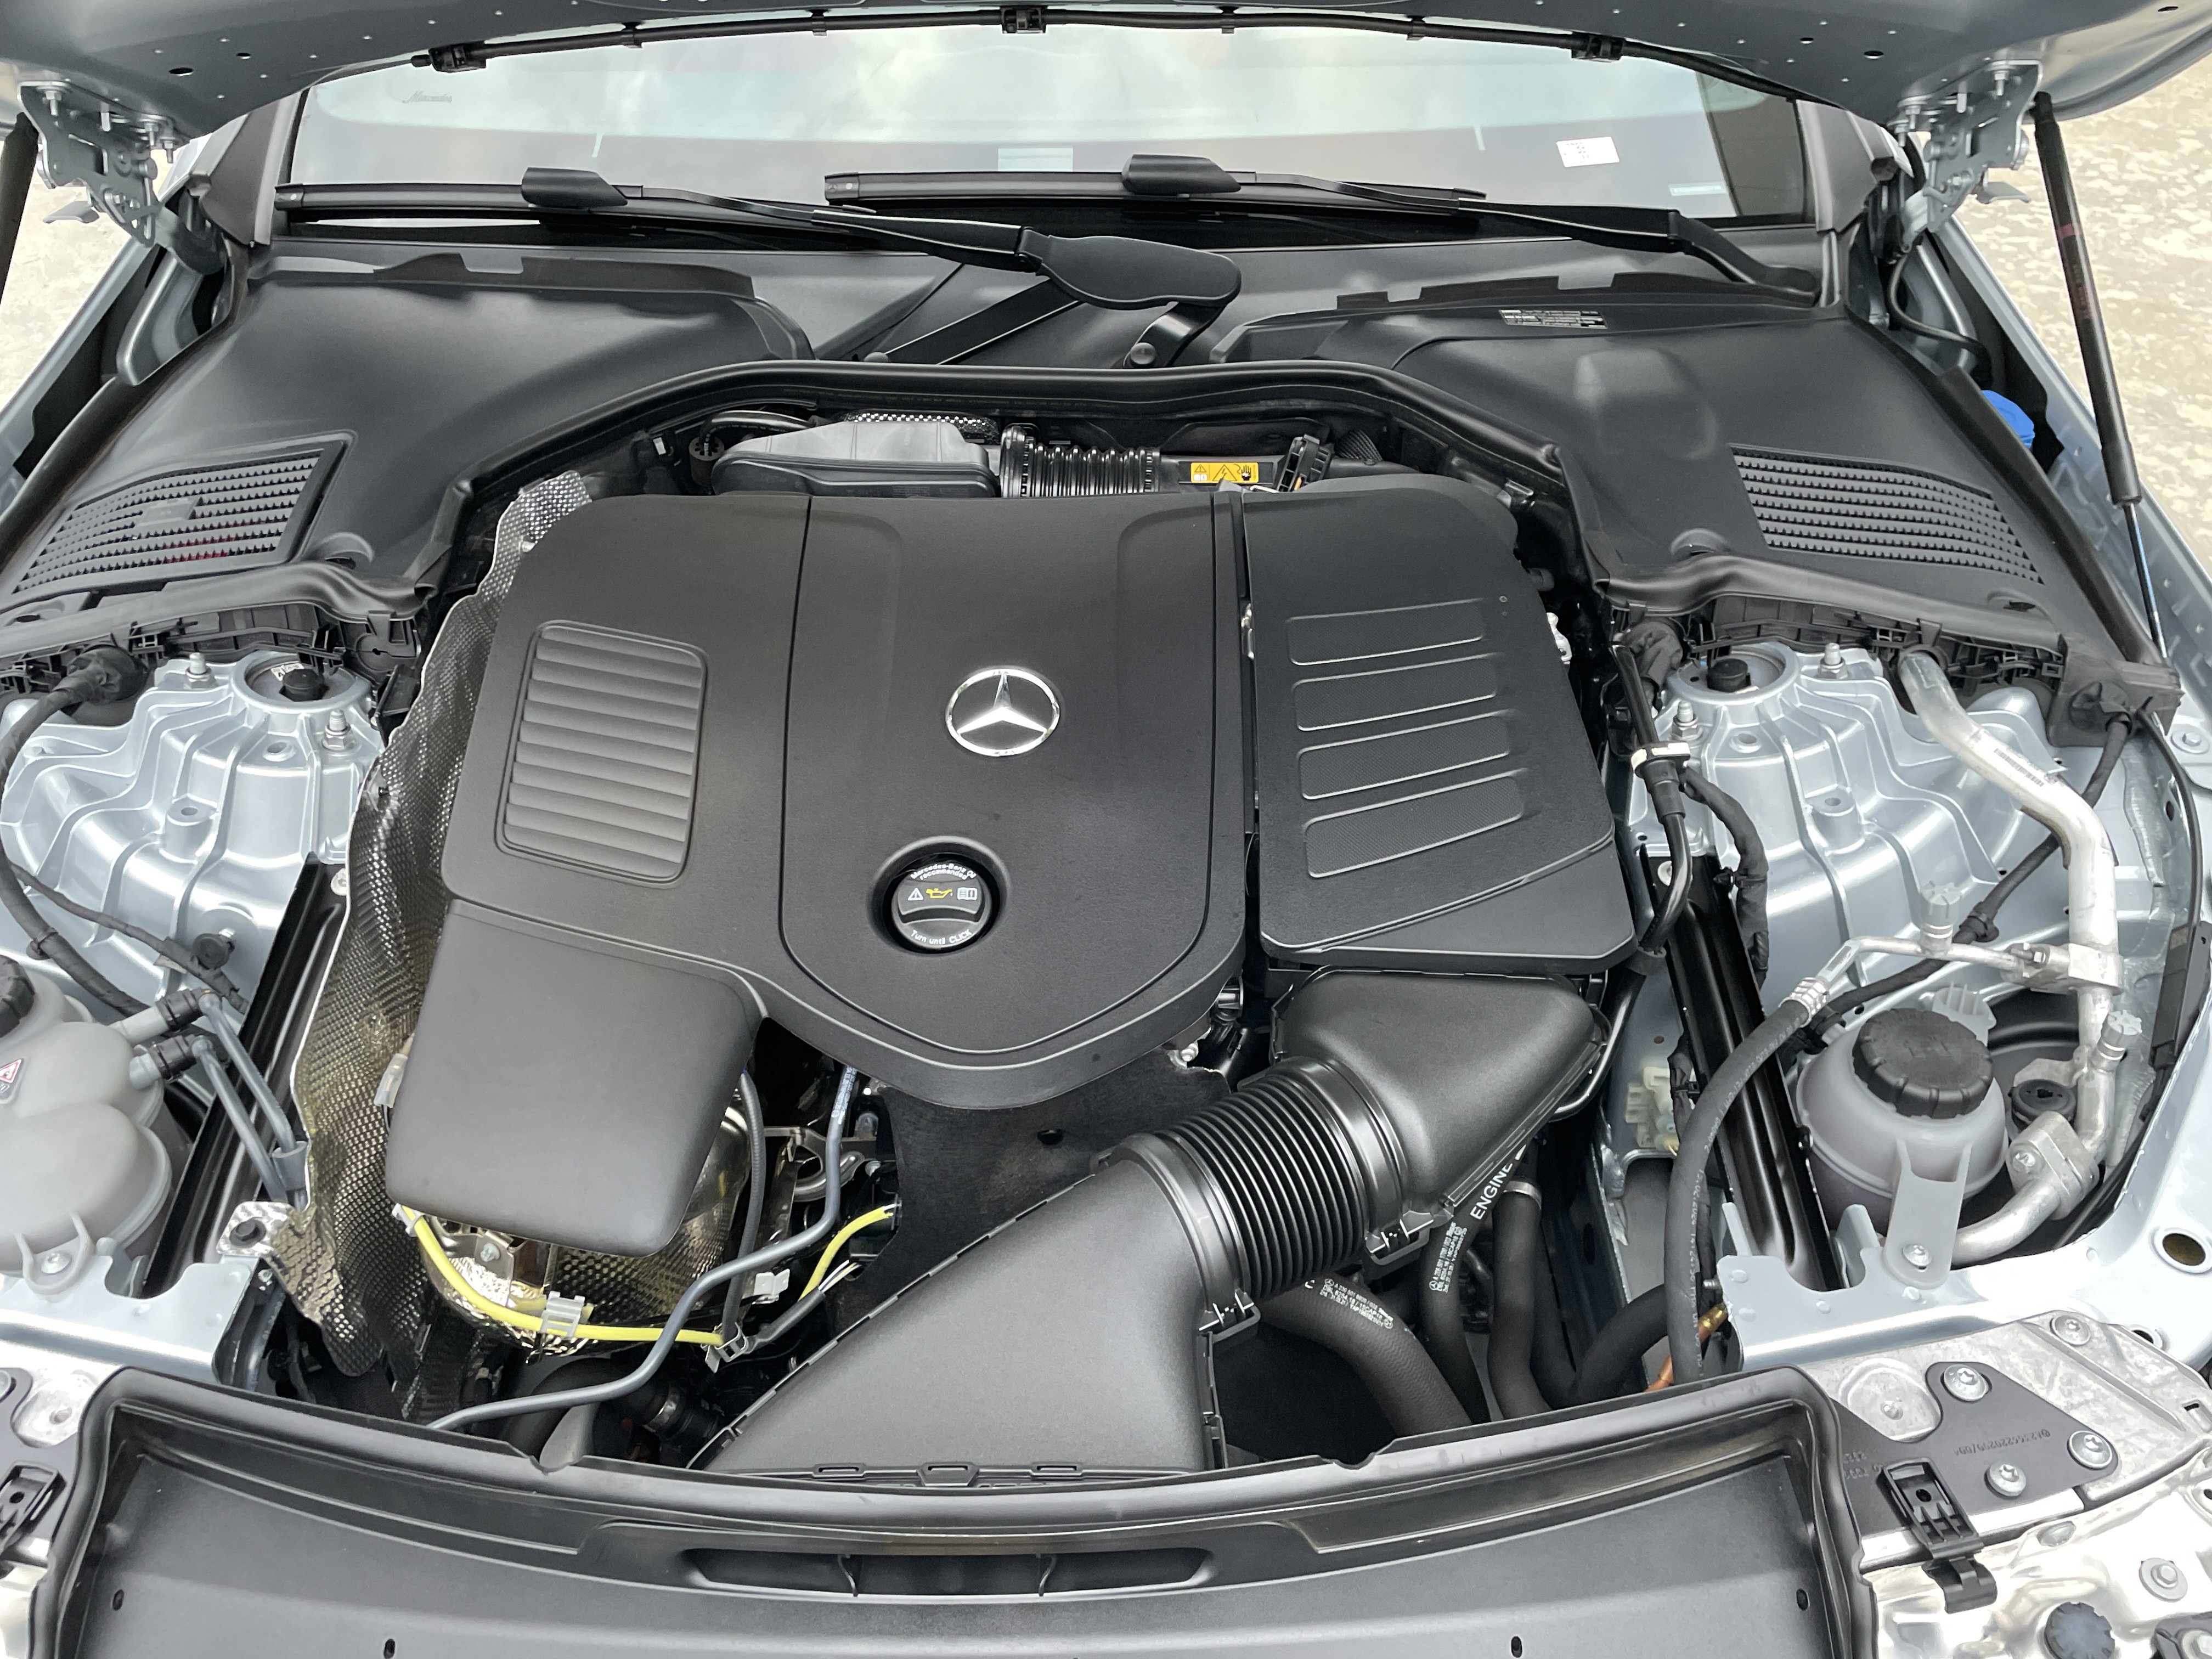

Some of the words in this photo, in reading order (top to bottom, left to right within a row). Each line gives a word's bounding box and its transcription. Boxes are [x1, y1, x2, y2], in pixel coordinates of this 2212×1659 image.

[910, 863, 967, 879] Mercedes-Benz
[919, 869, 968, 880] recommended
[911, 929, 927, 943] Turn
[949, 929, 972, 944] CLICK
